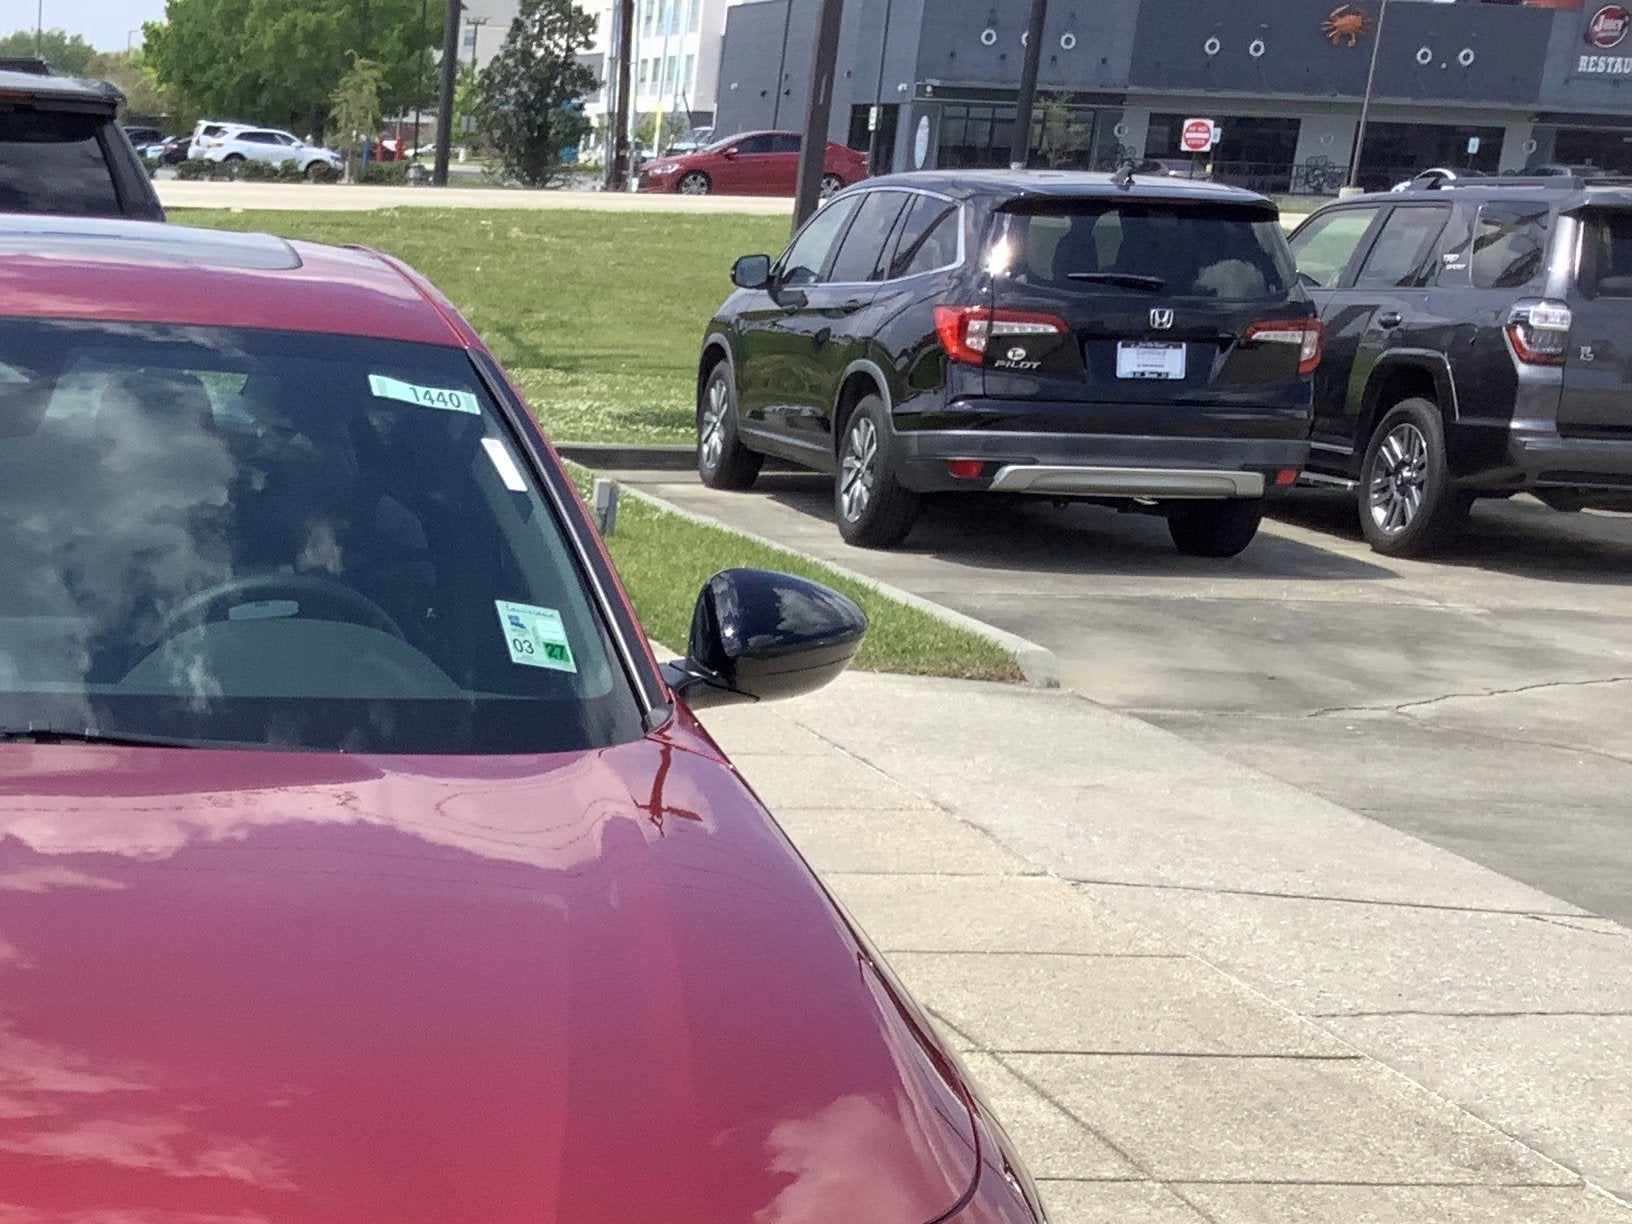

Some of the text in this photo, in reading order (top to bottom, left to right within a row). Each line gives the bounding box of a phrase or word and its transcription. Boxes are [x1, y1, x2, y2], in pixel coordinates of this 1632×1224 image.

[994, 360, 1042, 369] PILOT
[409, 387, 462, 409] 1440
[513, 638, 534, 655] 03
[544, 642, 567, 660] 27
